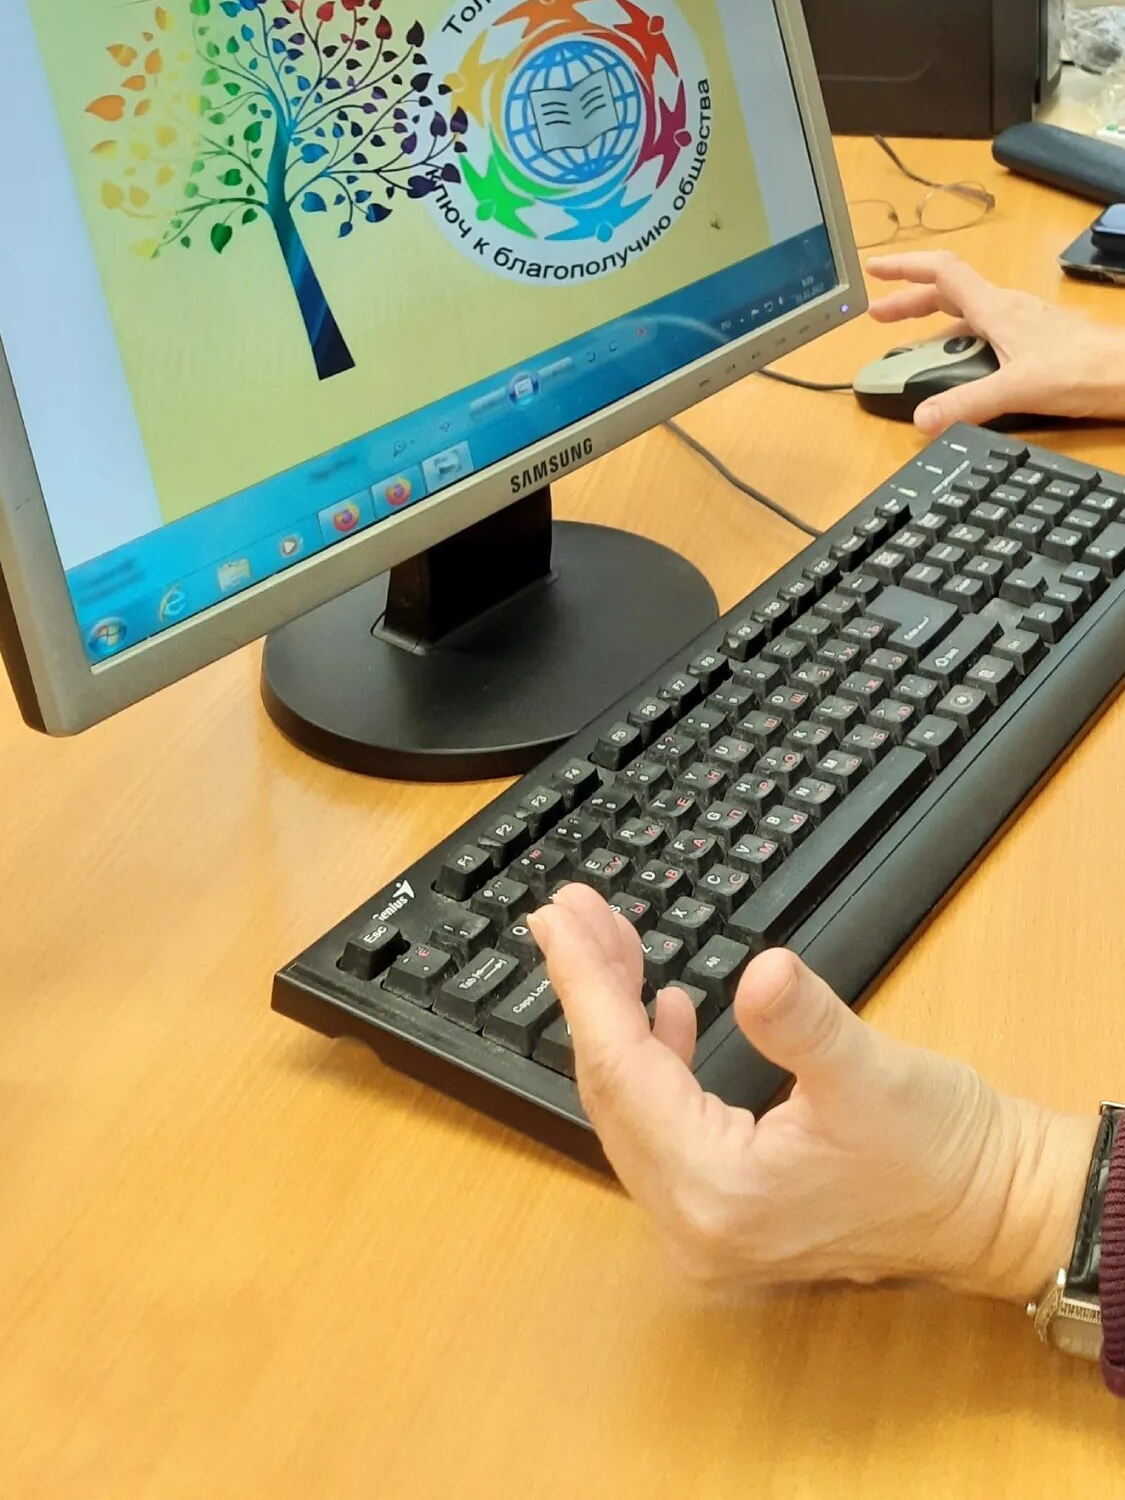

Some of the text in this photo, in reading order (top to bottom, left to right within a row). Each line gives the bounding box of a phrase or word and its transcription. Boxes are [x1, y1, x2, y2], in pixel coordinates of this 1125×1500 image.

[473, 237, 491, 256] к
[493, 214, 673, 280] благополучию
[673, 78, 712, 212] общества
[510, 437, 594, 494] SAMSUNG
[737, 626, 751, 637] F9
[671, 679, 686, 691] F7
[640, 703, 657, 715] F6
[611, 730, 627, 742] F5
[564, 767, 581, 780] F4
[531, 795, 548, 808] F3
[706, 811, 722, 822] G
[495, 823, 513, 837] F2
[620, 829, 636, 840] R
[673, 841, 686, 851] F
[457, 854, 474, 868] F1
[585, 860, 601, 870] E
[641, 871, 656, 881] D
[363, 925, 388, 944] Esc
[459, 973, 480, 991] Tab
[512, 978, 551, 1014] Caps Lock
